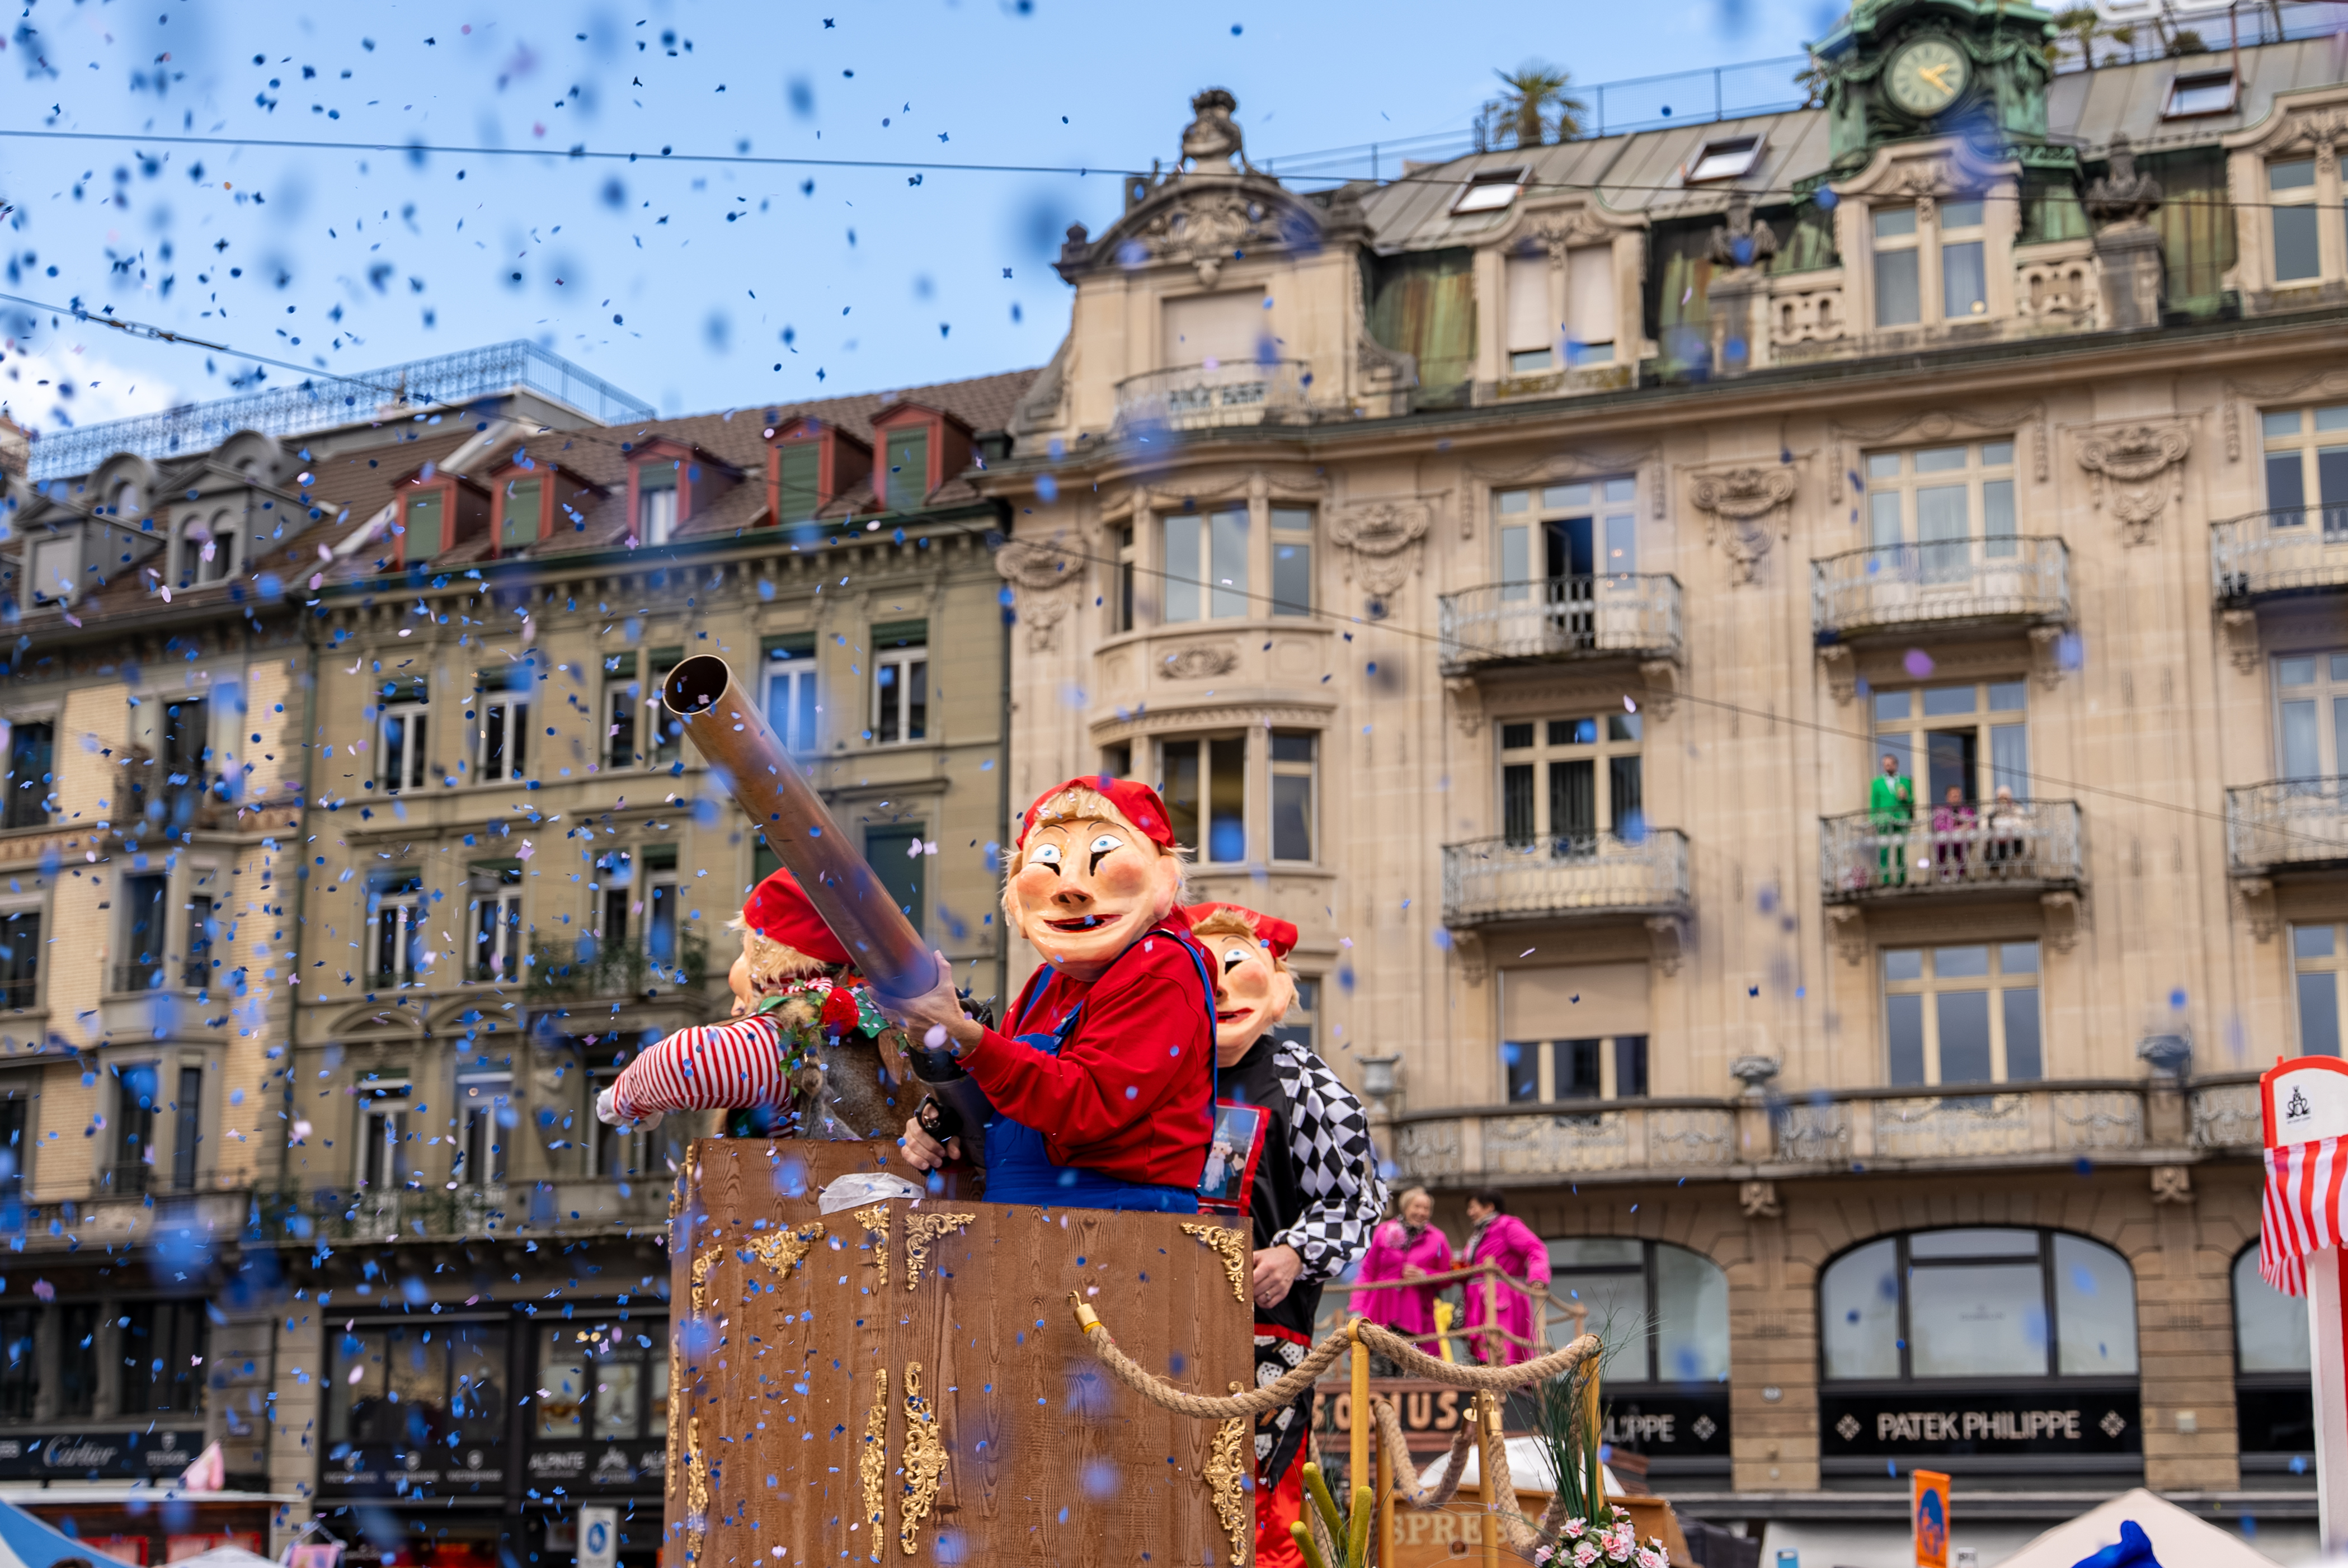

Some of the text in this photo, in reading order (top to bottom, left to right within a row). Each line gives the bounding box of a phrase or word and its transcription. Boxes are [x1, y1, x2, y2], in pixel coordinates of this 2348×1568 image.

[1877, 1410, 2082, 1440] PATEK PHILIPPE
[43, 1435, 118, 1467] Cartier
